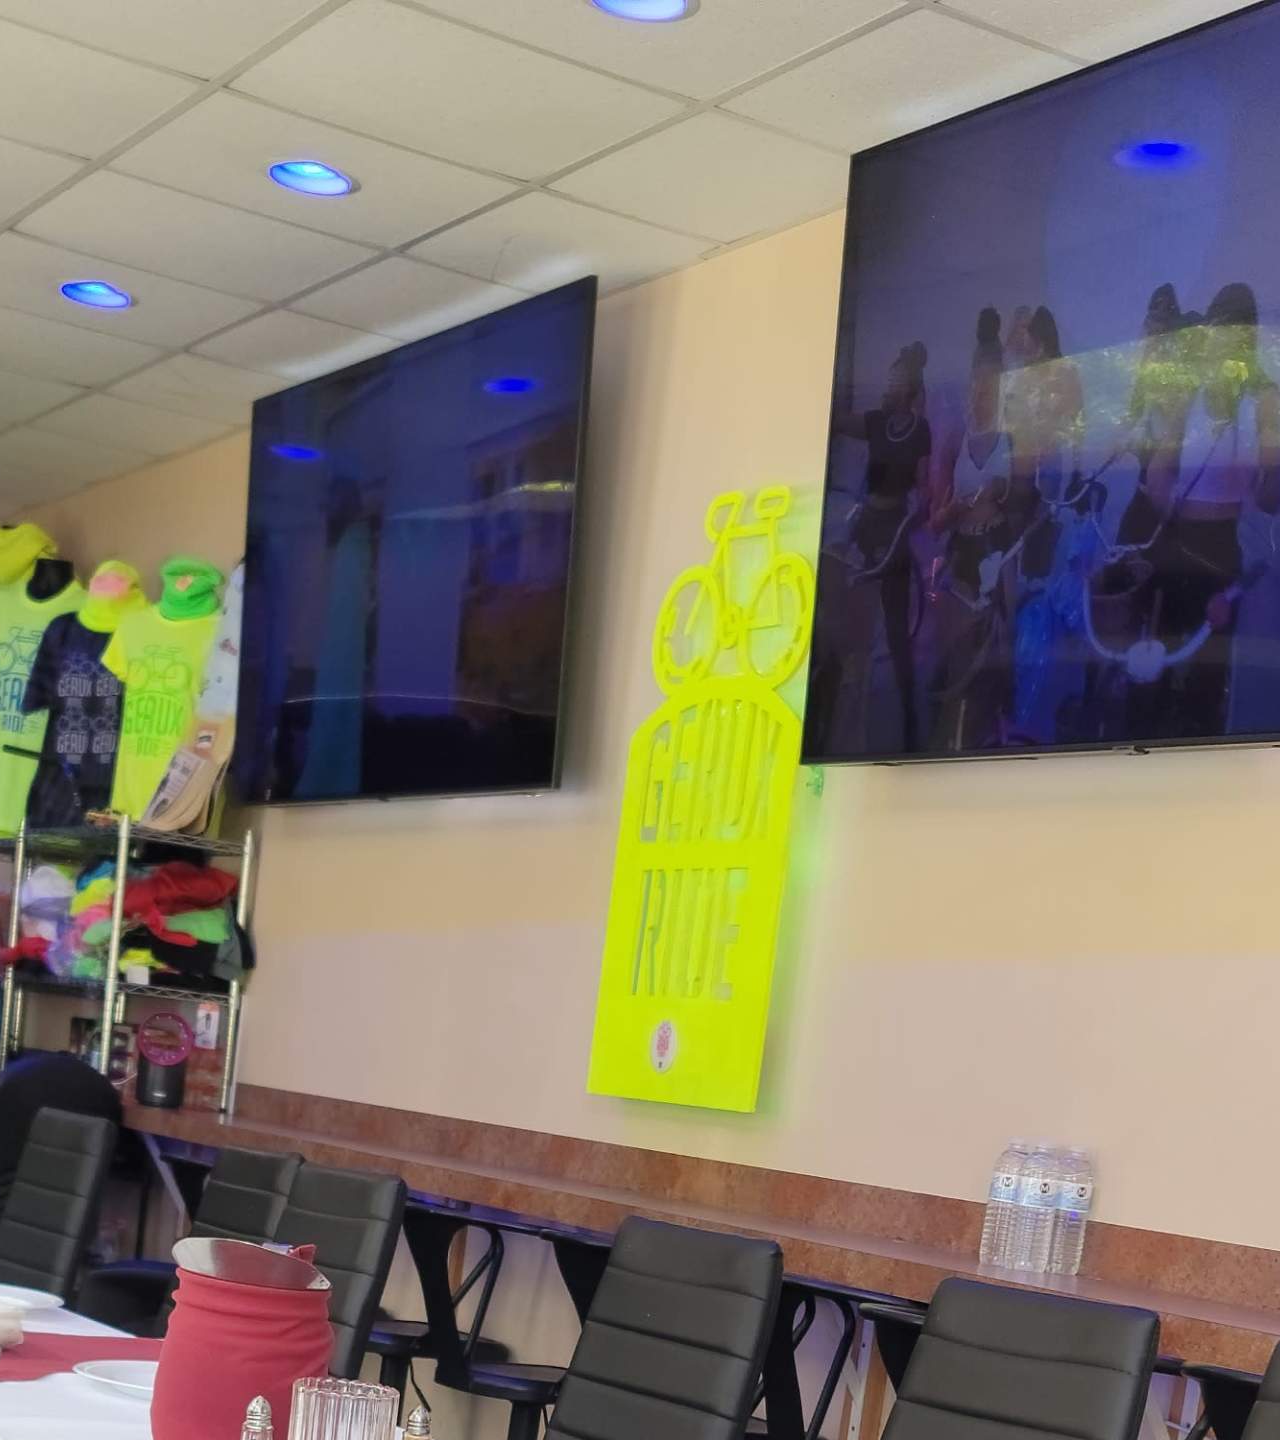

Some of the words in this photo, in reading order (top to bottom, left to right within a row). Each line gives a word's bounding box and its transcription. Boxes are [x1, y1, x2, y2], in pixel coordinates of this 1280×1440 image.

[96, 676, 120, 697] GEAU
[92, 733, 116, 755] GEAU
[640, 698, 783, 843] GEAUX
[632, 866, 749, 1001] RIDE
